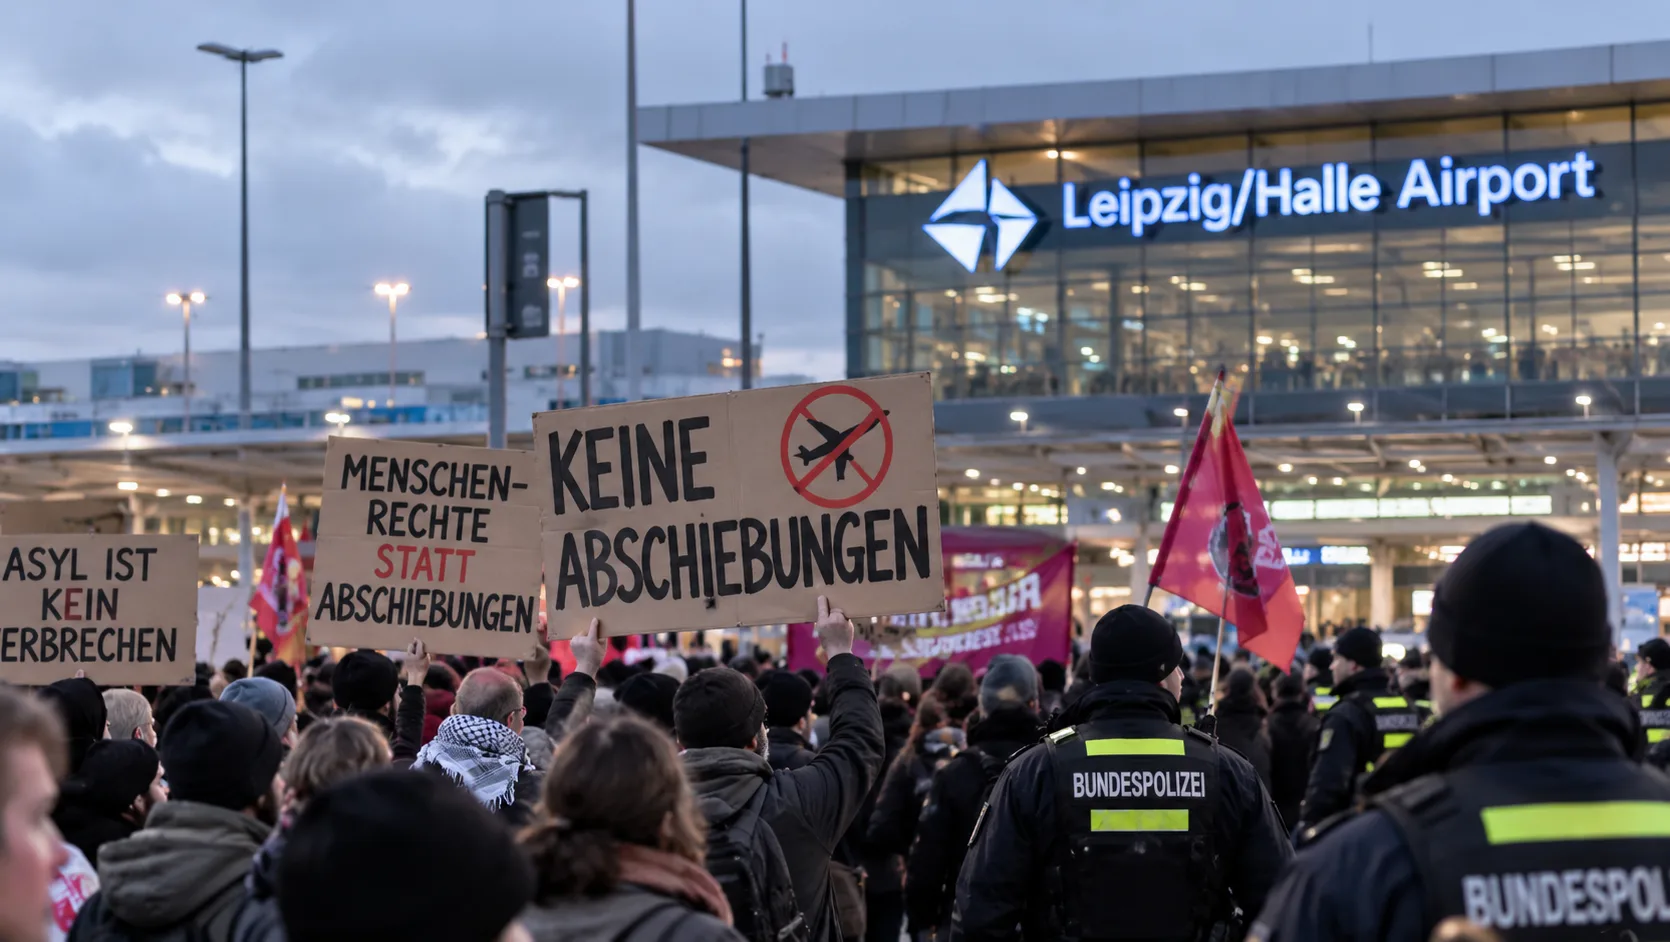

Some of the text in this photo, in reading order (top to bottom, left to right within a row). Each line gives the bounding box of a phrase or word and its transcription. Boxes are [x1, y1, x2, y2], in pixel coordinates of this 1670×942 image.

[1064, 152, 1594, 235] Leipzig/Halle Airport
[341, 454, 528, 501] MENSCHEN-
[548, 416, 715, 515] KEINE
[367, 499, 491, 543] RECHTE
[3, 547, 157, 581] ASYL IST
[375, 543, 475, 583] STATT
[556, 505, 931, 610] ABSCHIEBUNGEN
[42, 588, 118, 620] KEIN
[315, 582, 534, 633] ABSCHIEBUNGEN
[0, 627, 177, 662] ERBRECHEN
[1073, 771, 1205, 798] BUNDESPOLIZEI
[1462, 866, 1670, 929] BUNDESPOL
